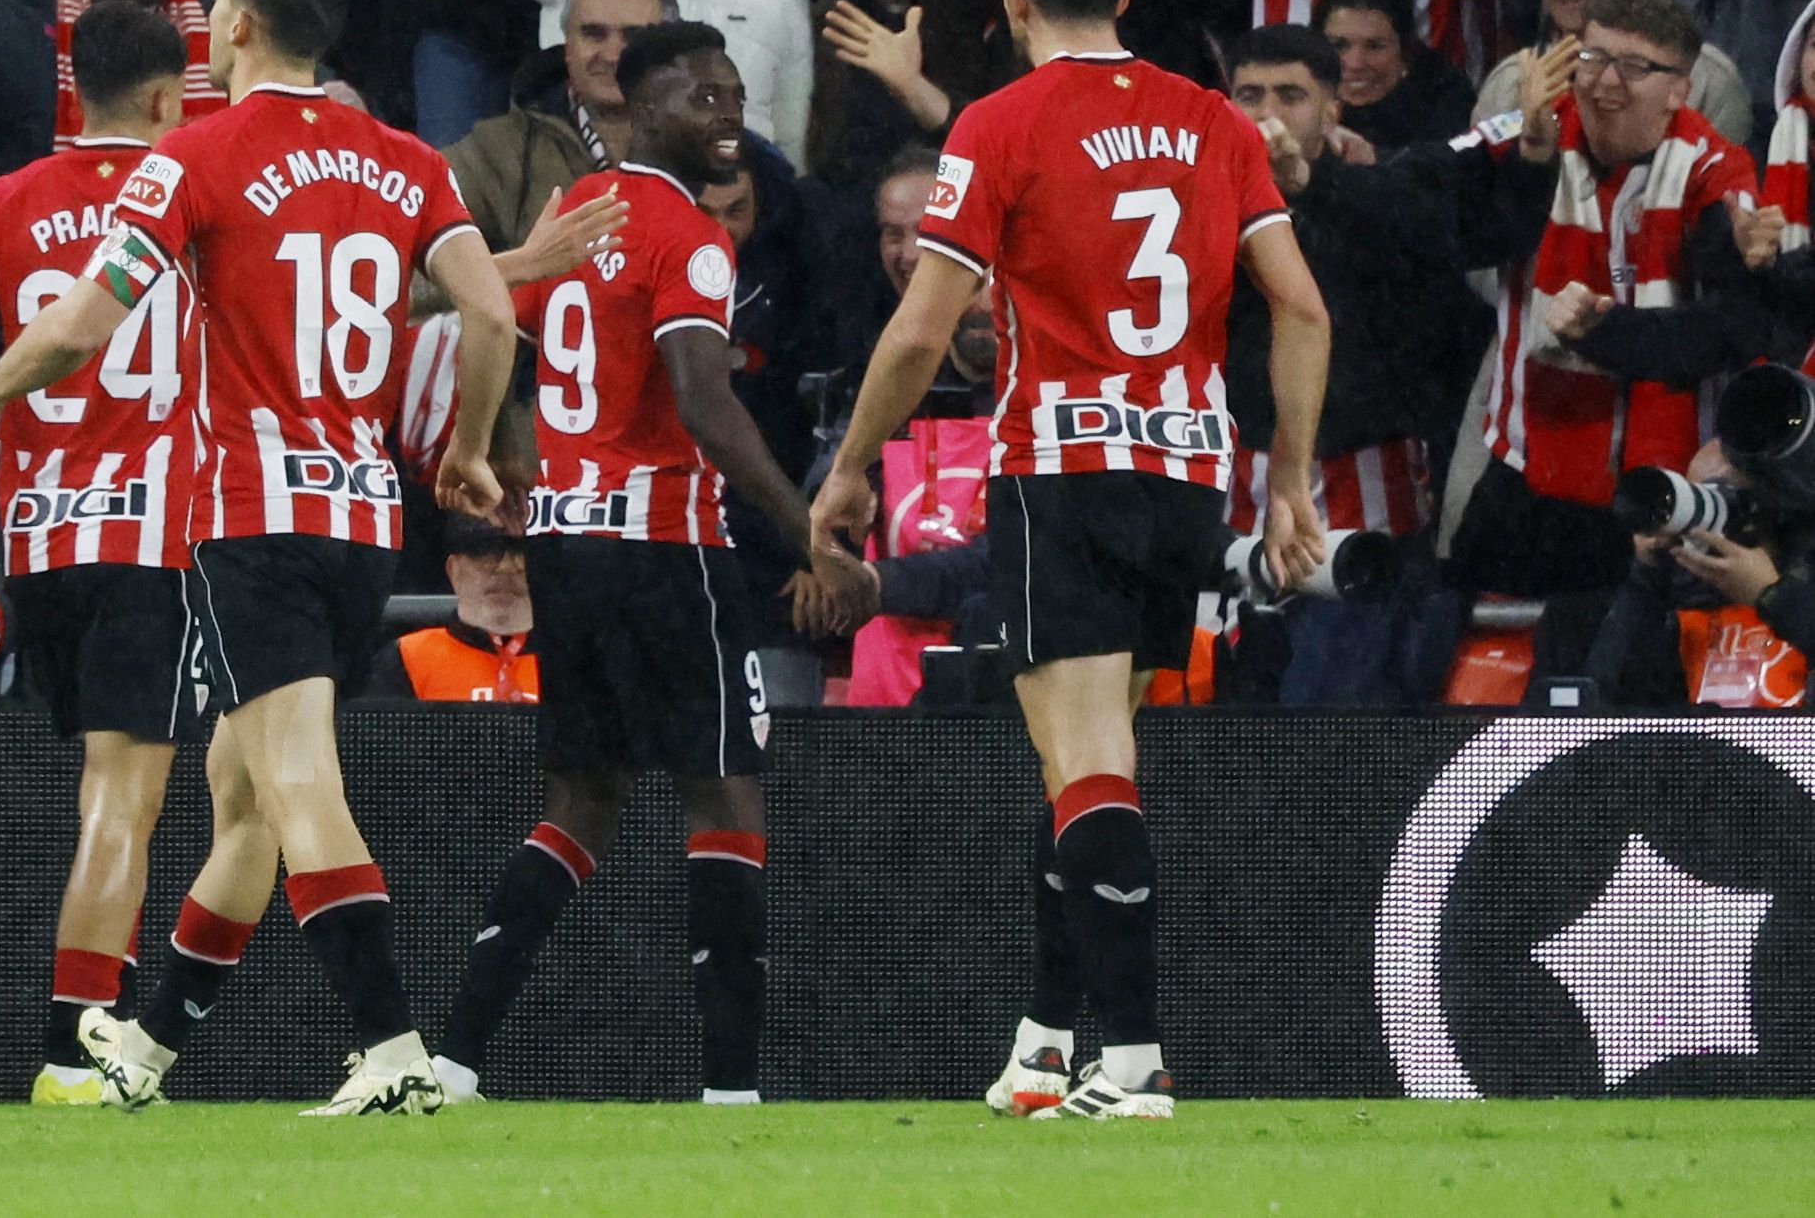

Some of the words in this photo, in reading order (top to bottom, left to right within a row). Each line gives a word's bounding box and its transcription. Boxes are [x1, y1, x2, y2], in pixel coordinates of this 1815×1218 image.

[1080, 125, 1199, 170] VIVIAN
[243, 163, 293, 217] DE
[285, 149, 425, 217] MARCOS
[1107, 187, 1189, 357] 3
[274, 231, 401, 400] 18
[538, 280, 599, 435] 9
[1054, 402, 1224, 451] DIGI
[12, 482, 147, 528] DIGI
[743, 650, 767, 714] 9
